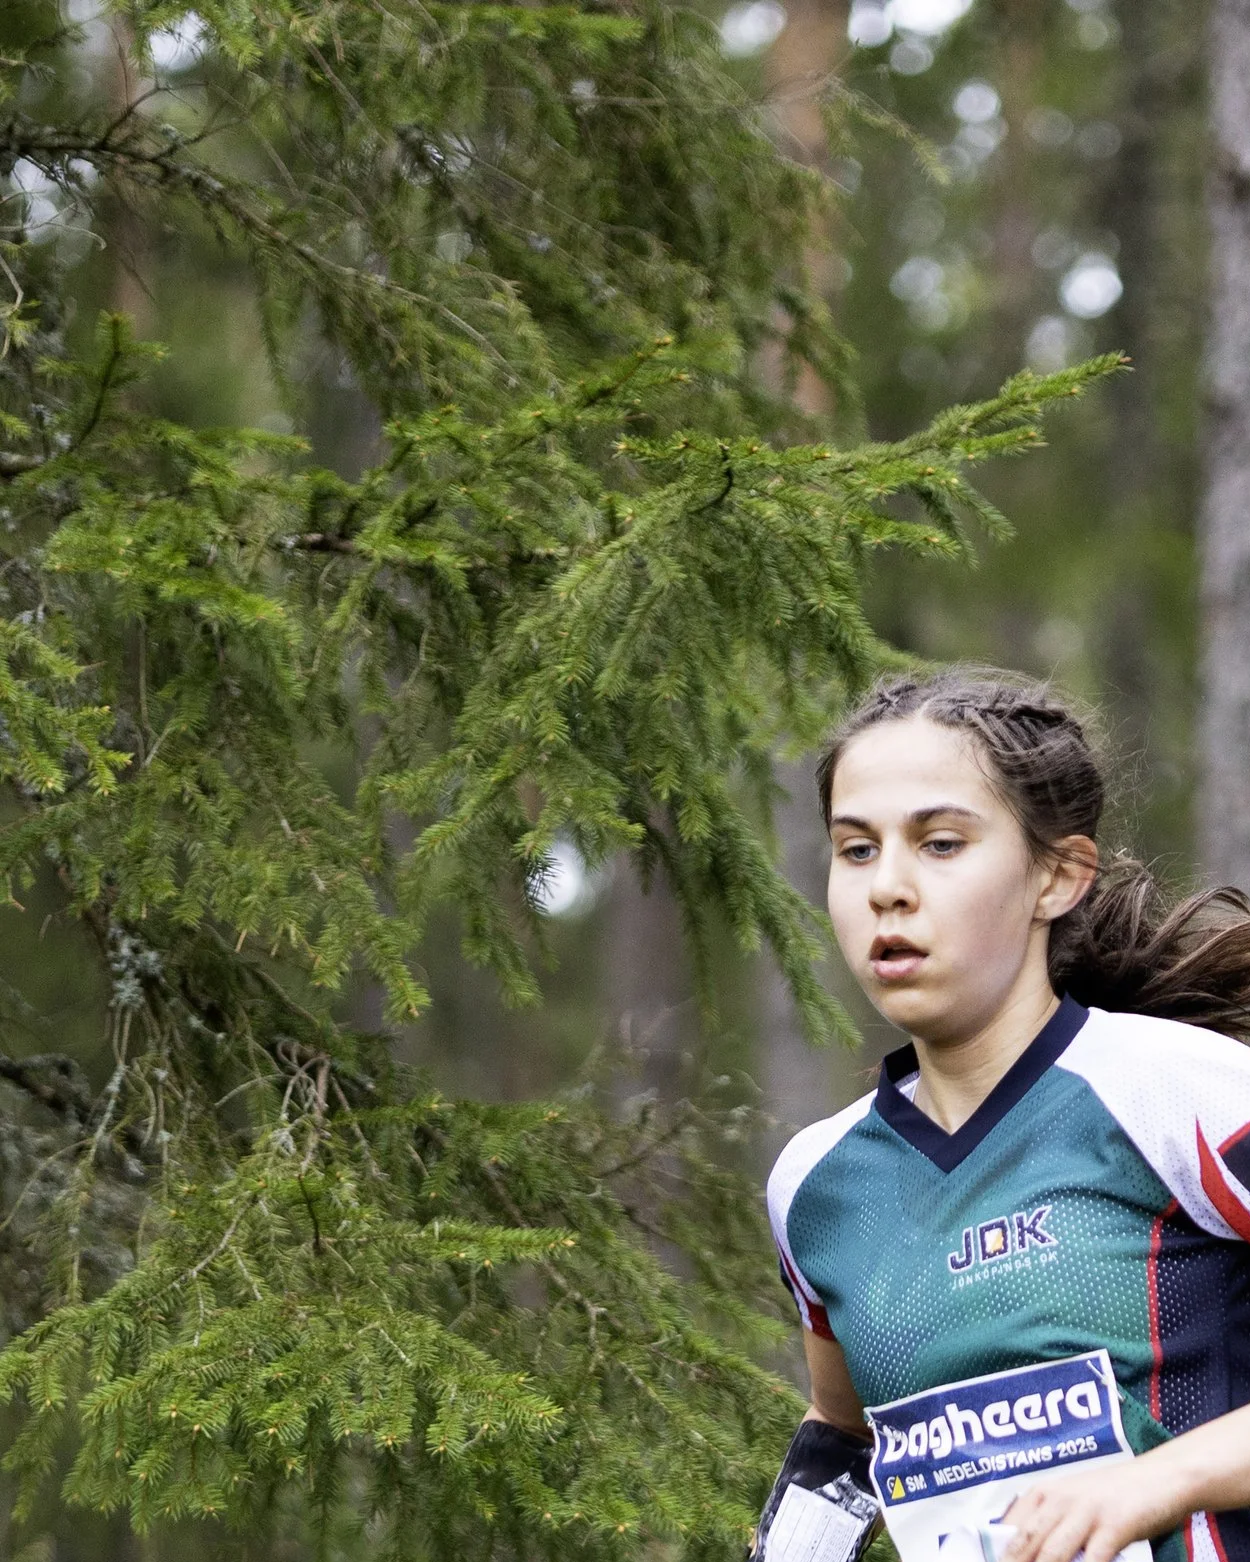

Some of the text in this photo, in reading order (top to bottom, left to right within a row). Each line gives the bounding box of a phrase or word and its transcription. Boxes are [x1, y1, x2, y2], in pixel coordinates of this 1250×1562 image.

[948, 1205, 1059, 1273] JOK
[882, 1380, 1101, 1464] bagheera
[905, 1436, 1098, 1492] SM MEDELDISTANS 2025
